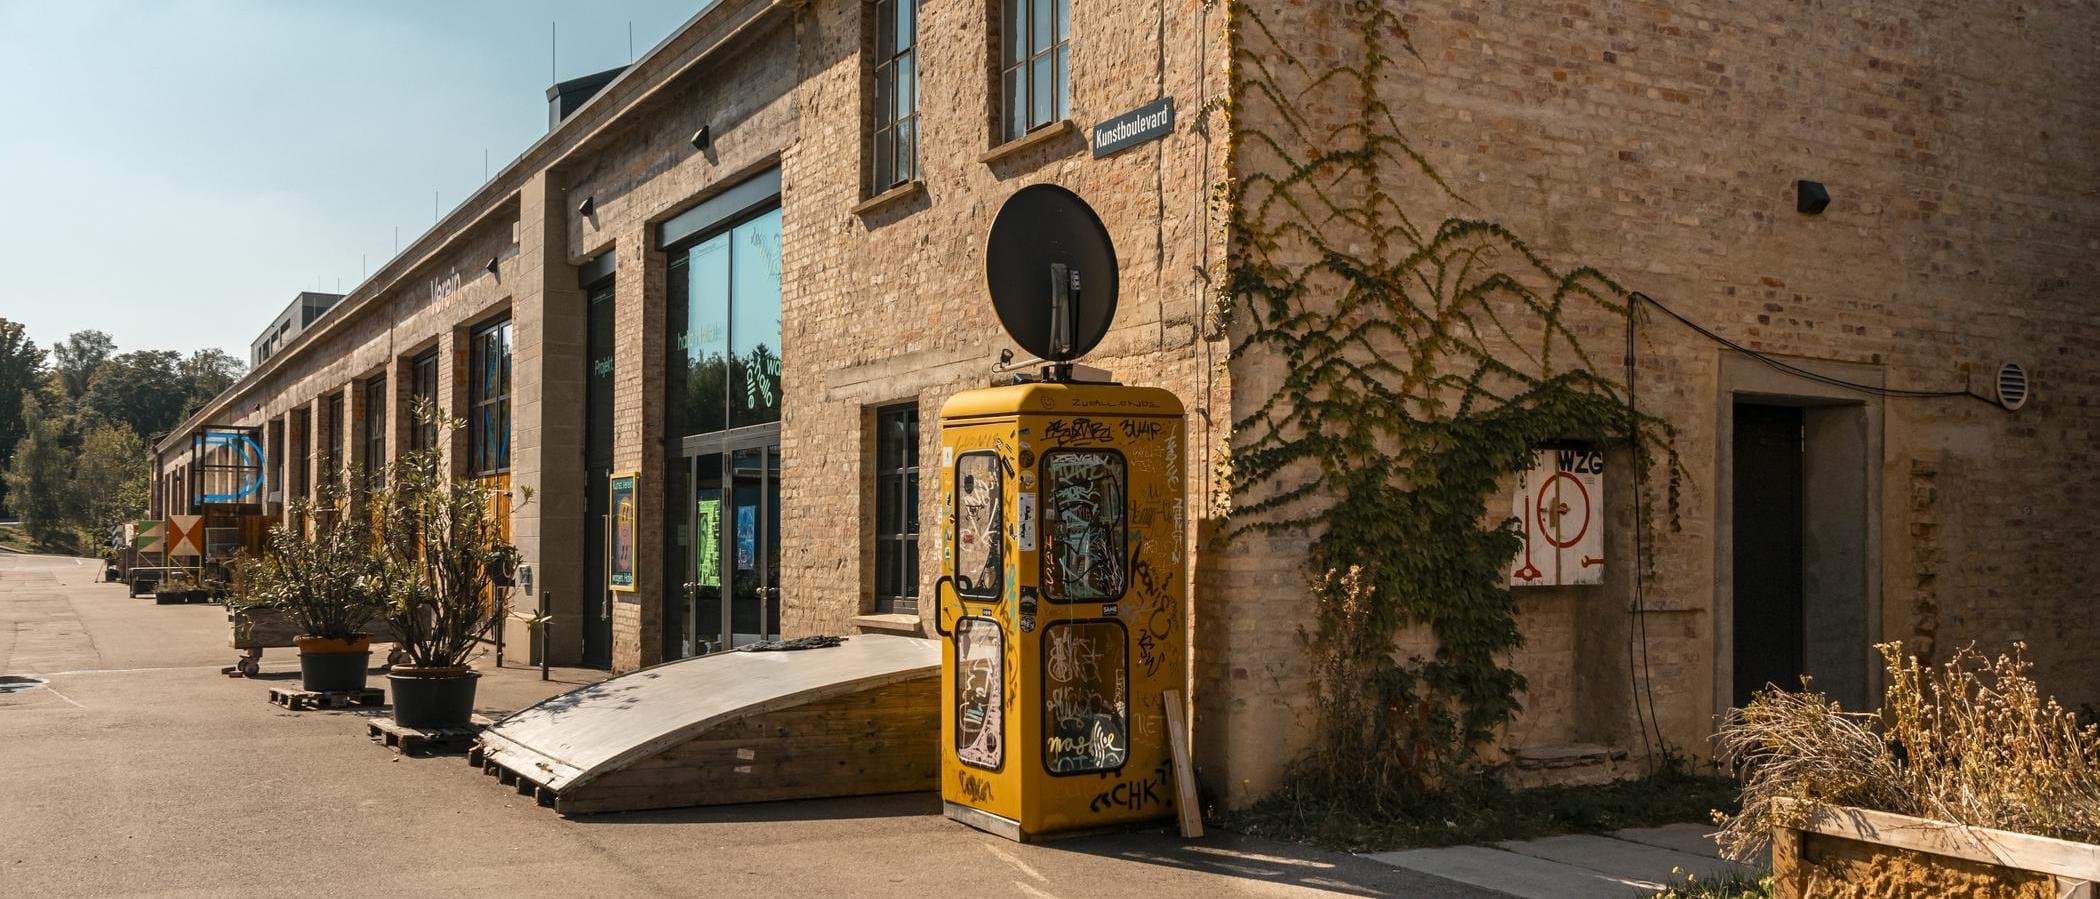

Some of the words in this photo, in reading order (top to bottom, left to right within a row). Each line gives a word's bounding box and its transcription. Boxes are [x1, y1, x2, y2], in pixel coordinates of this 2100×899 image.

[1096, 104, 1169, 150] Kunstboulevard
[754, 357, 773, 408] hallo
[1559, 449, 1604, 475] WZG
